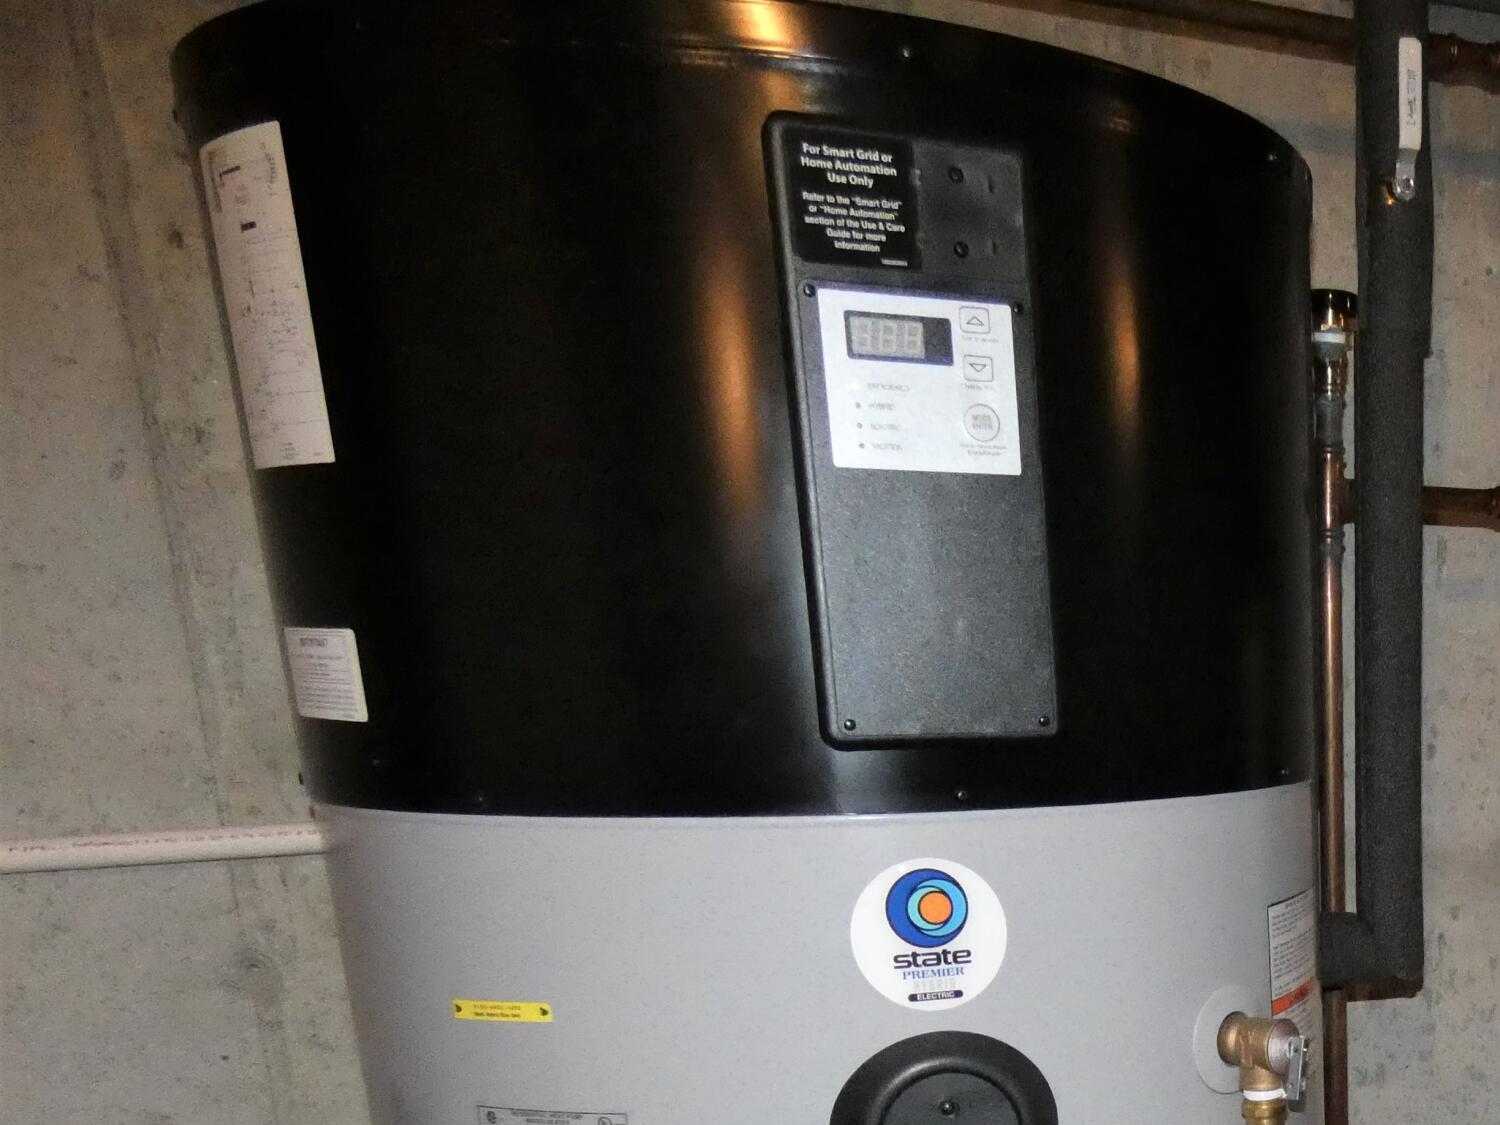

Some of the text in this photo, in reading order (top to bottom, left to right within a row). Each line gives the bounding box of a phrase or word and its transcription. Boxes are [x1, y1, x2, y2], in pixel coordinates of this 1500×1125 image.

[802, 142, 821, 154] For
[823, 146, 854, 159] Smart
[857, 151, 878, 161] Grid
[801, 157, 897, 176] Home Automation
[827, 173, 873, 188] Use Only
[802, 192, 824, 202] Refer
[837, 196, 850, 204] the
[805, 216, 835, 226] section
[847, 220, 859, 228] the
[886, 224, 905, 232] Care
[826, 229, 850, 238] Guide
[893, 948, 972, 969] state
[902, 968, 964, 980] PREMIER
[917, 991, 955, 1001] ELECTRIC
